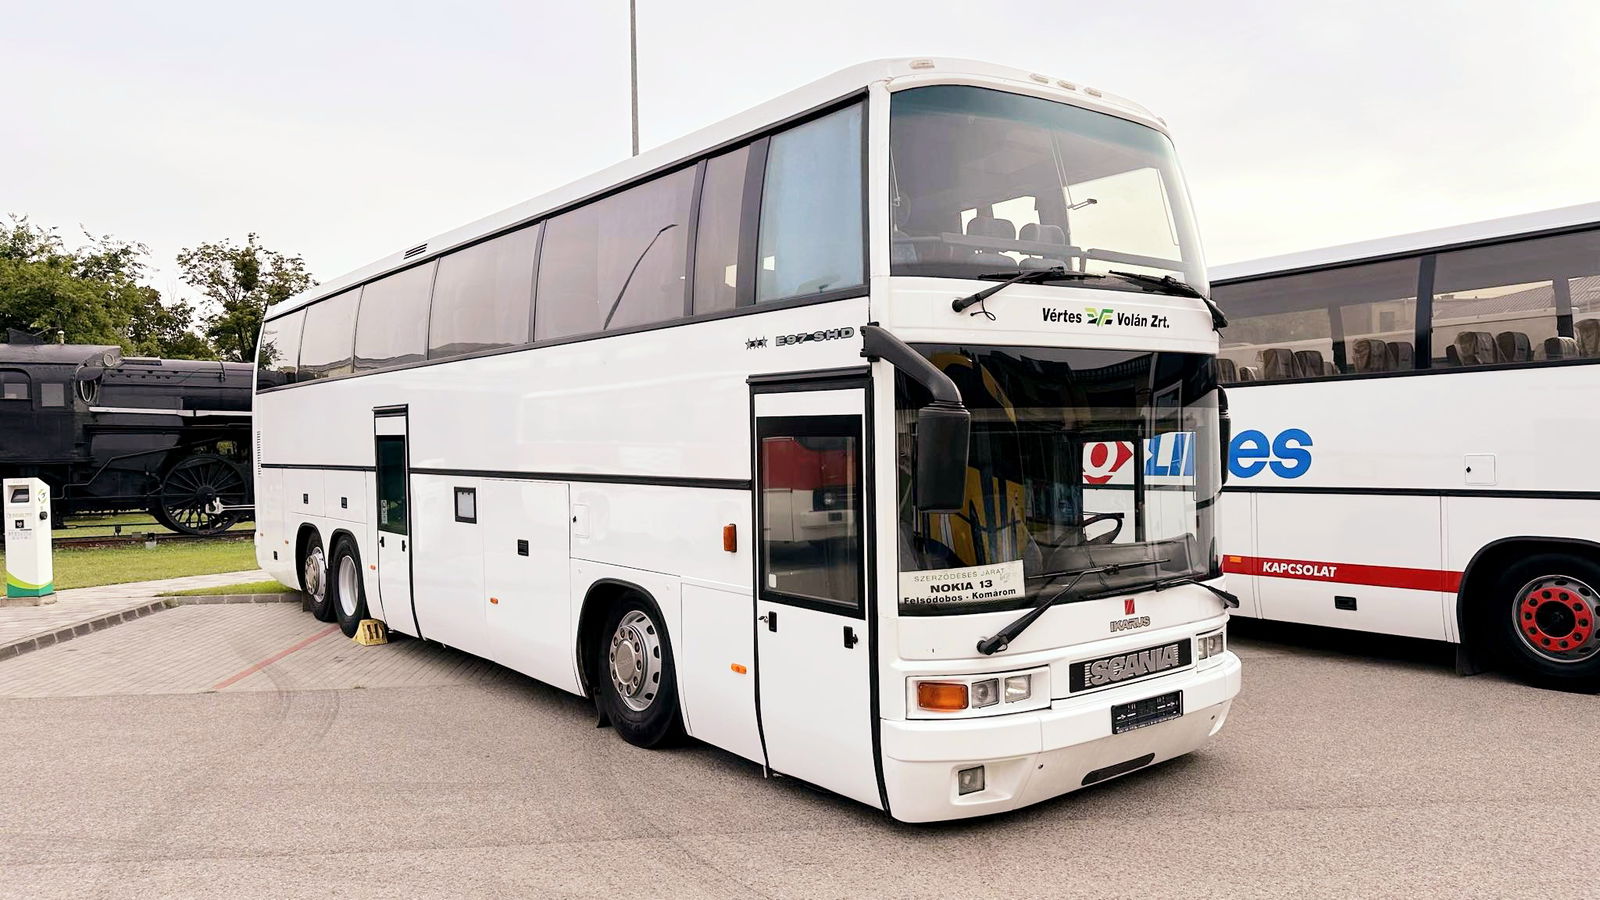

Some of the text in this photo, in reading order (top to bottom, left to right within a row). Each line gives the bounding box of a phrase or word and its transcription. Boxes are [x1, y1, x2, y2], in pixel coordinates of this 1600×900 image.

[1042, 307, 1170, 329] Vértes Volán Zrt.
[775, 326, 855, 347] E97 SHD
[1262, 561, 1337, 578] KAPCSOLAT
[930, 579, 994, 593] NOKIA 13
[1109, 616, 1151, 633] IKARUS
[1090, 643, 1179, 686] SCANIA
